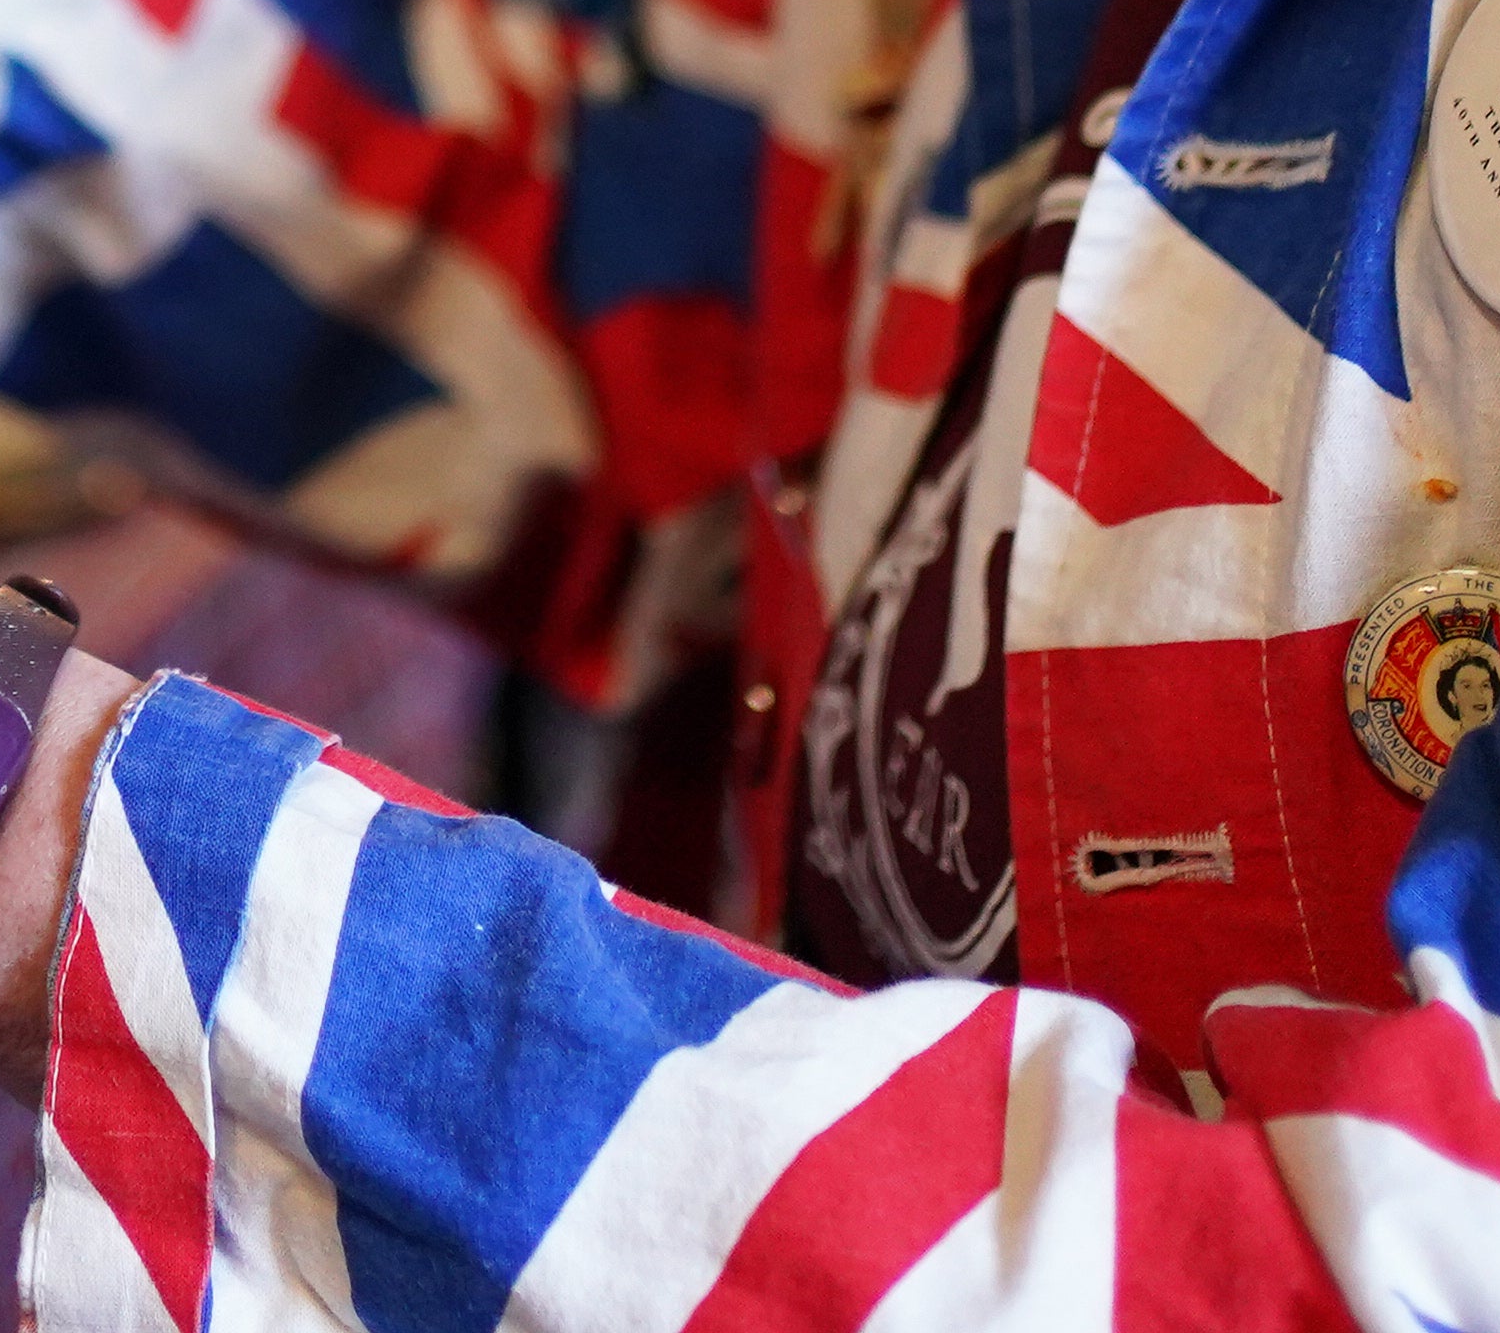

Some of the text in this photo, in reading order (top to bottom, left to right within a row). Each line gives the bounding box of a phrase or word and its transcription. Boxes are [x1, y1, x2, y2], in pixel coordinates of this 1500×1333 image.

[1452, 96, 1480, 147] 40TH
[1351, 578, 1494, 685] PRESENTED THE
[1371, 702, 1436, 781] CORONATION
